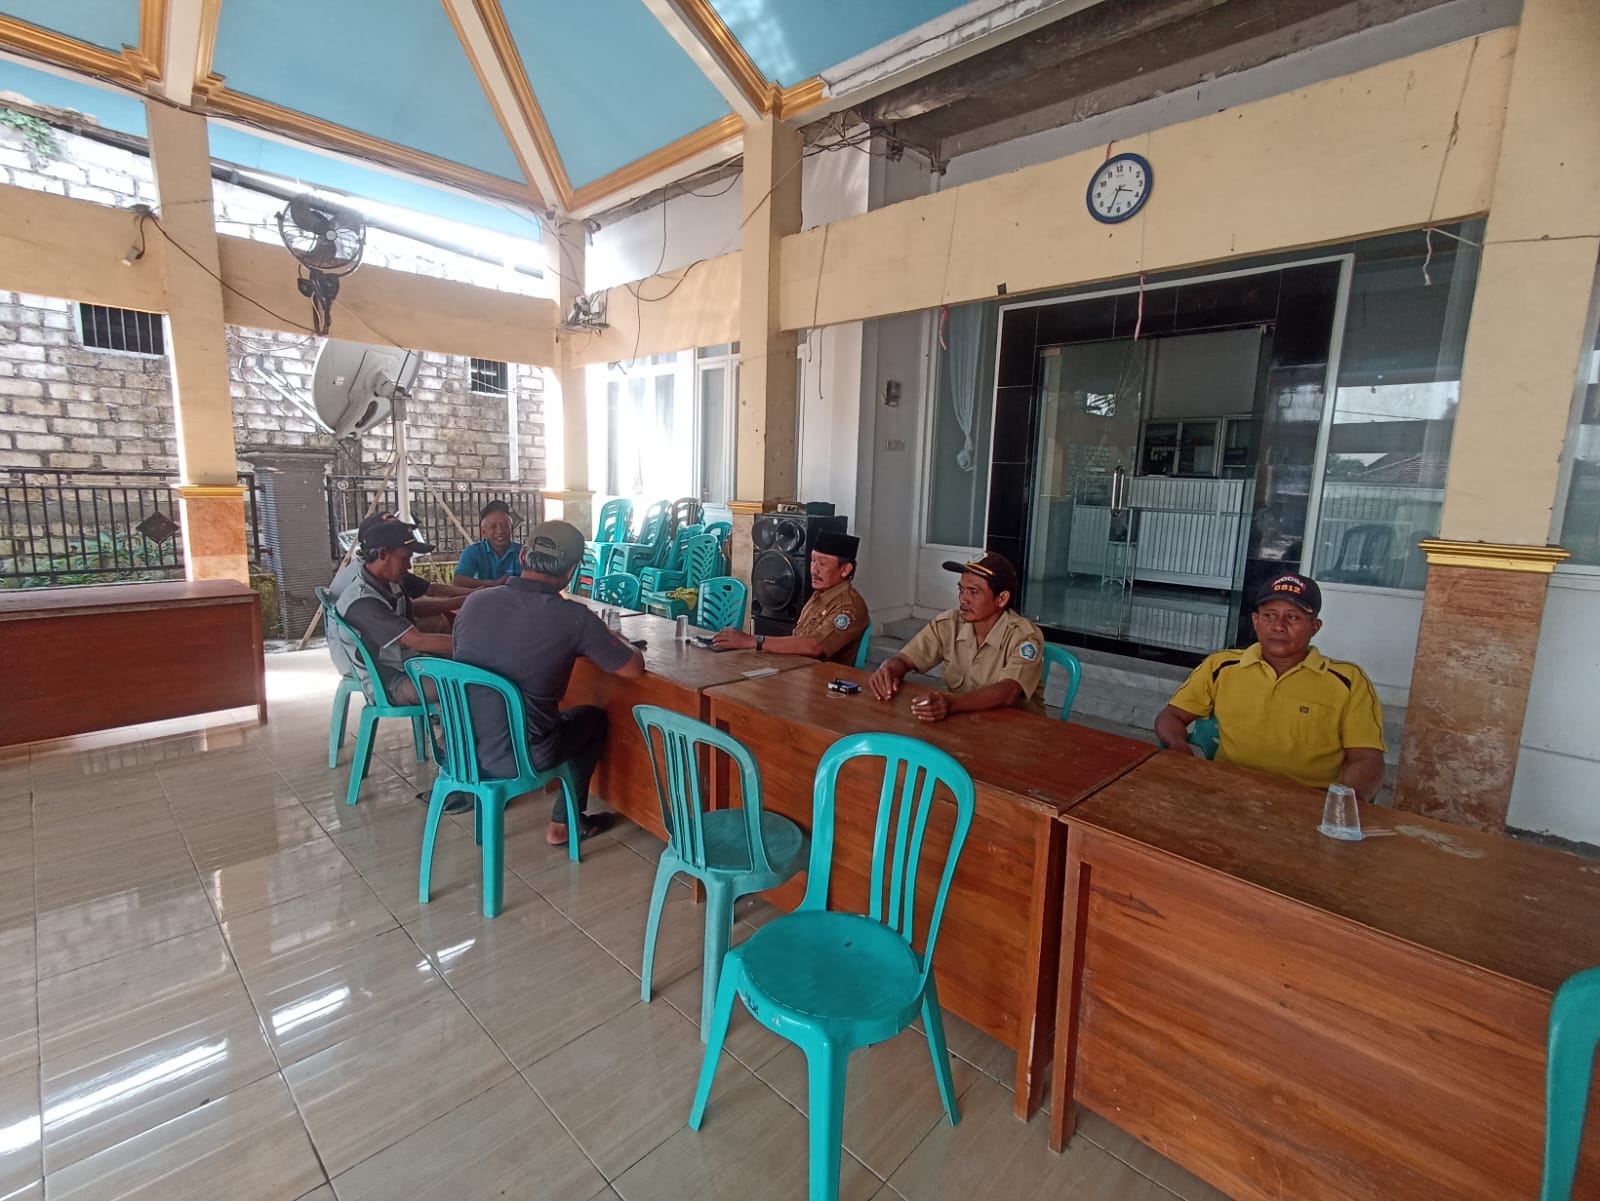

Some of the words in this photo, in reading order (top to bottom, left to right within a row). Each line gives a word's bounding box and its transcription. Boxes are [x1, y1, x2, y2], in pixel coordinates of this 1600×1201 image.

[1116, 165, 1124, 173] 12
[1108, 171, 1113, 179] 11
[1116, 206, 1121, 214] 6
